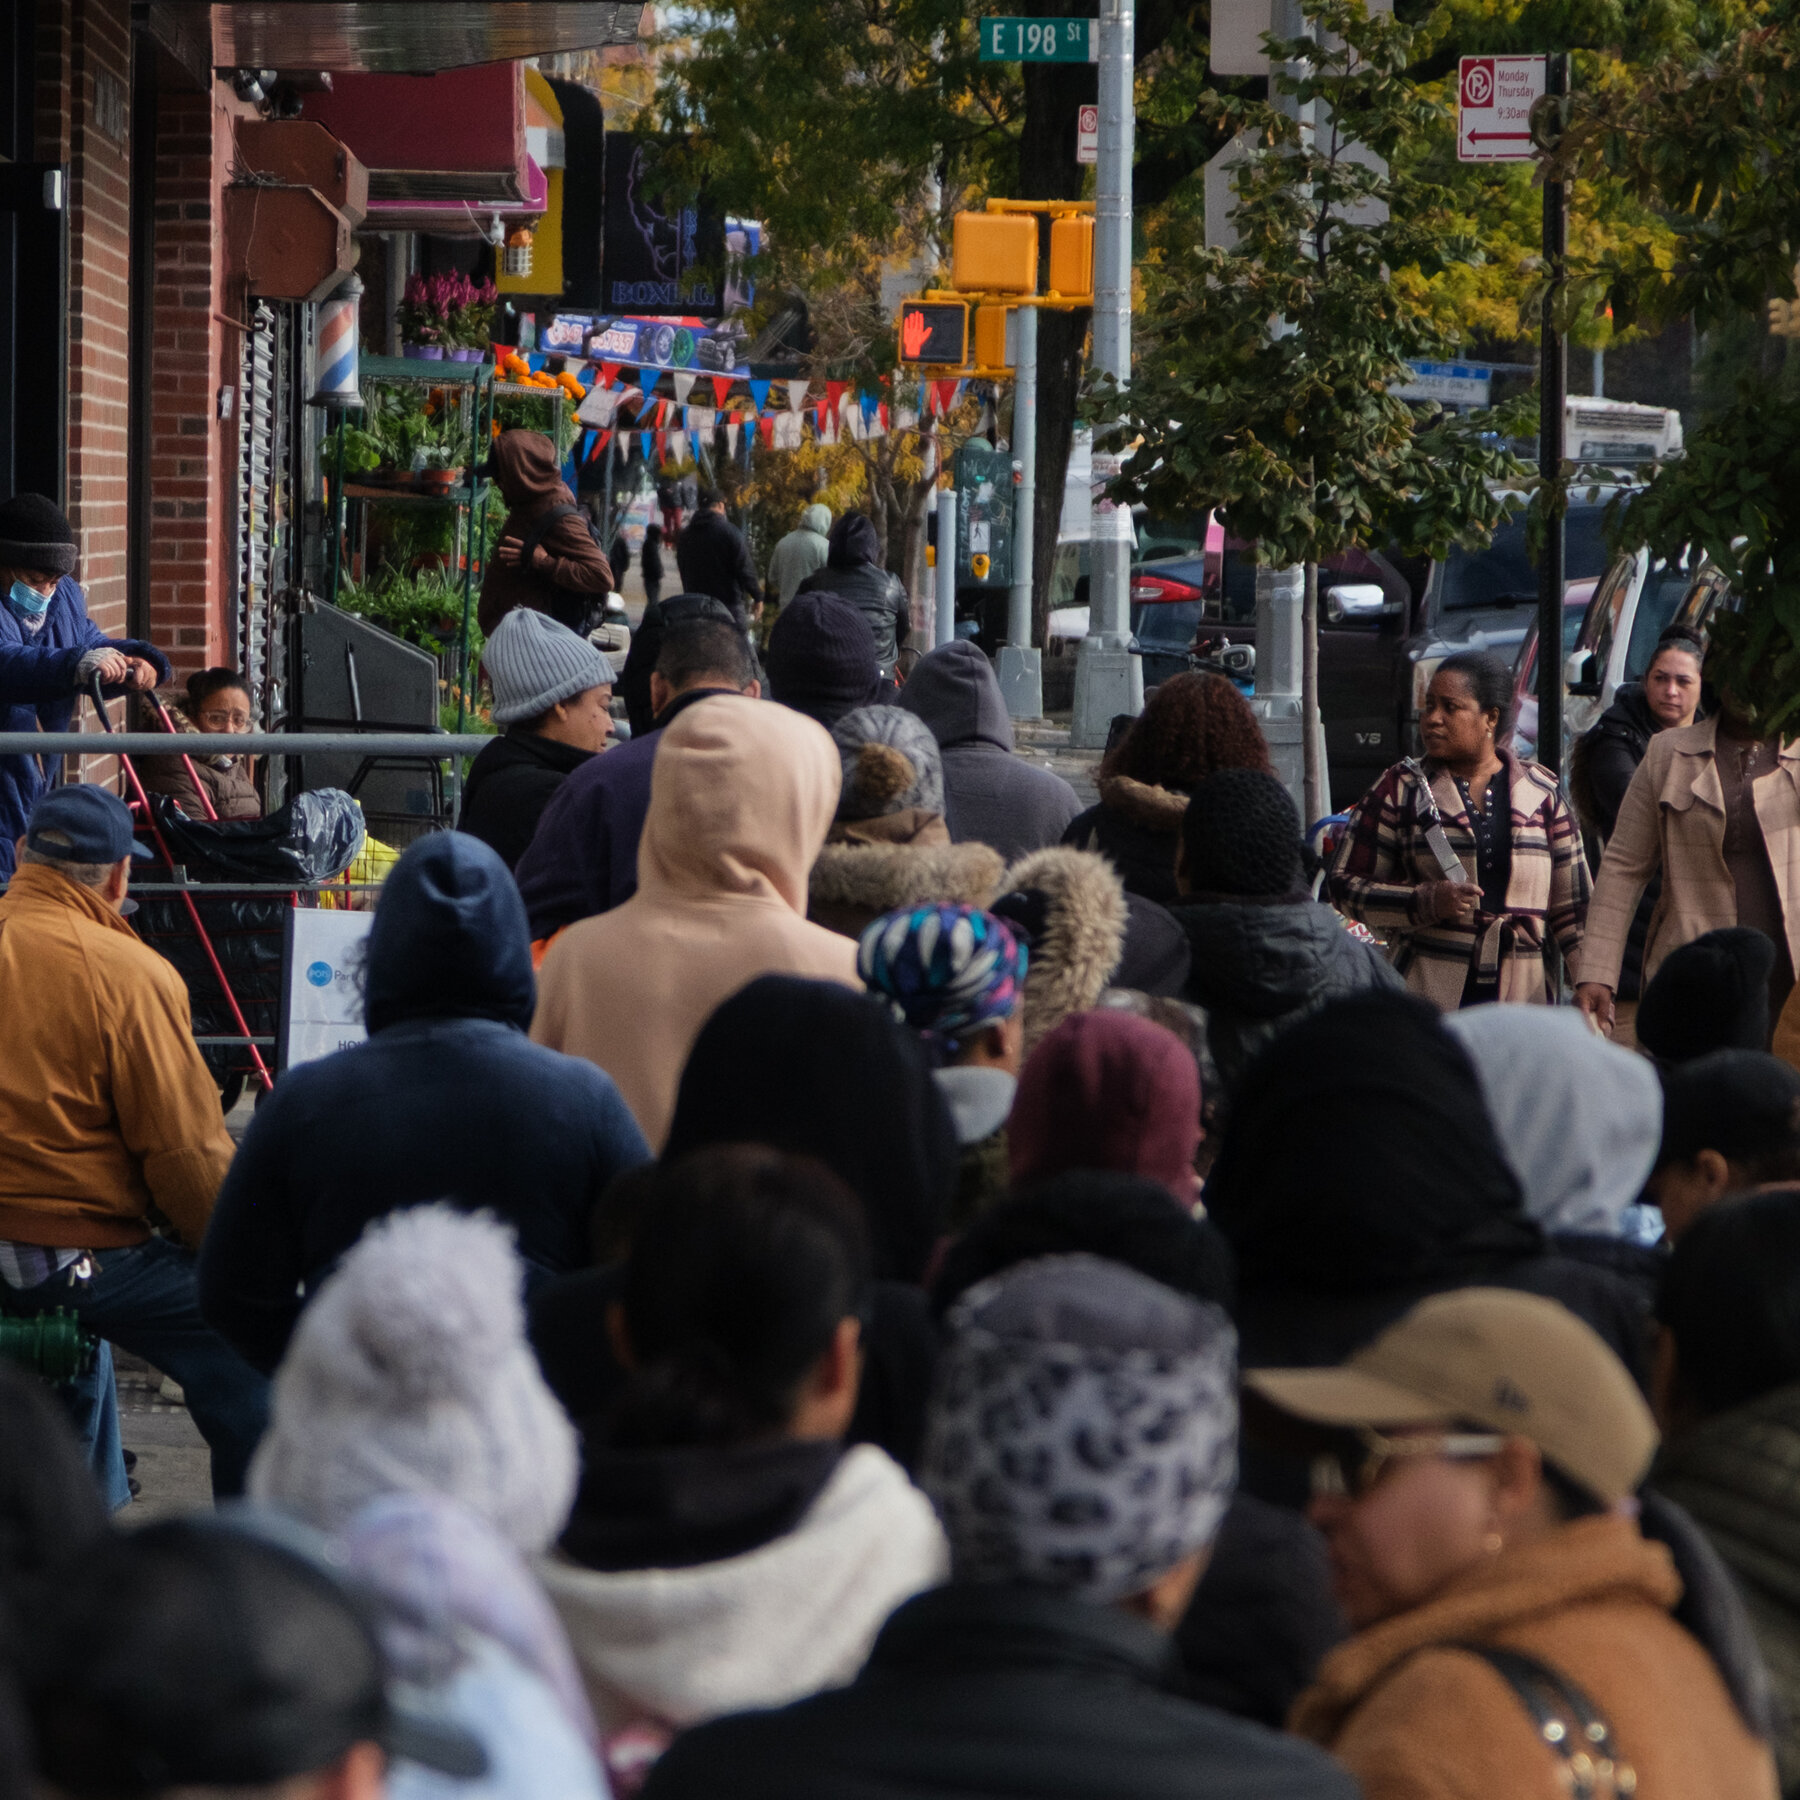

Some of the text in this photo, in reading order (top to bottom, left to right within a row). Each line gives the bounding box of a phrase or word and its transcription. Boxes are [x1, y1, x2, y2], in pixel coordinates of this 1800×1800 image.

[992, 22, 1081, 56] E 198 St
[1498, 69, 1529, 83] Monday
[1498, 85, 1535, 99] Thursday
[1497, 106, 1529, 120] 9:30am
[611, 280, 716, 306] BOXIG
